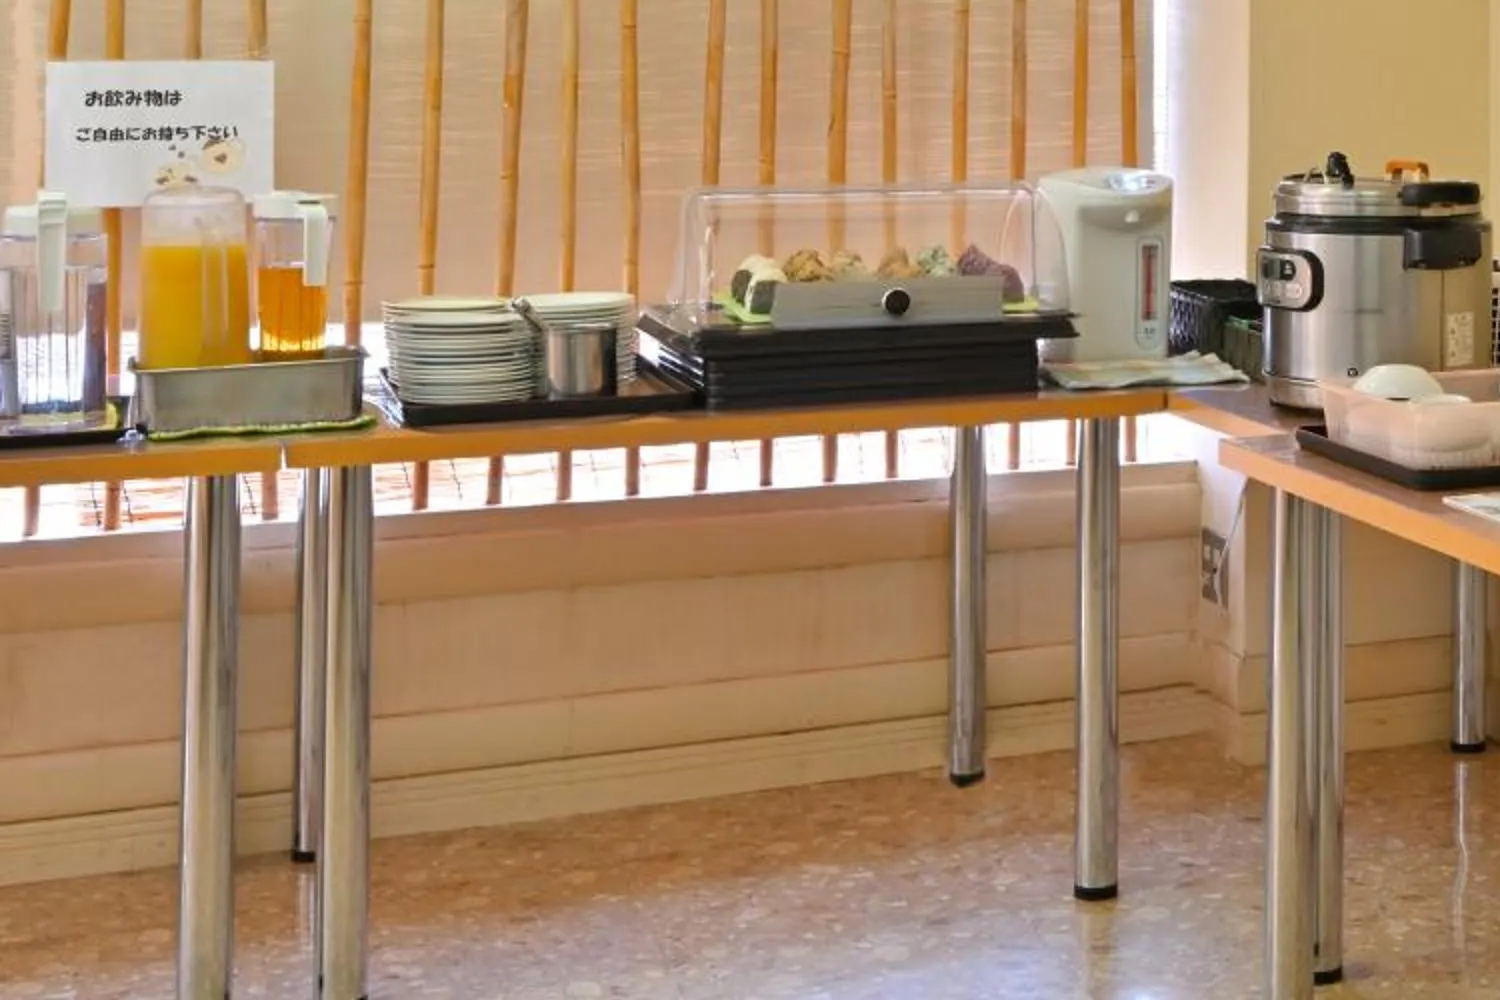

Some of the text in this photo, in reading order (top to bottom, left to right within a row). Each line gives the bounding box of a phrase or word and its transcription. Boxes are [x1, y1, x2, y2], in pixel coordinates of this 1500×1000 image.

[84, 89, 183, 107] お飲み物は
[75, 125, 239, 143] ご自由にお持ち下さい
